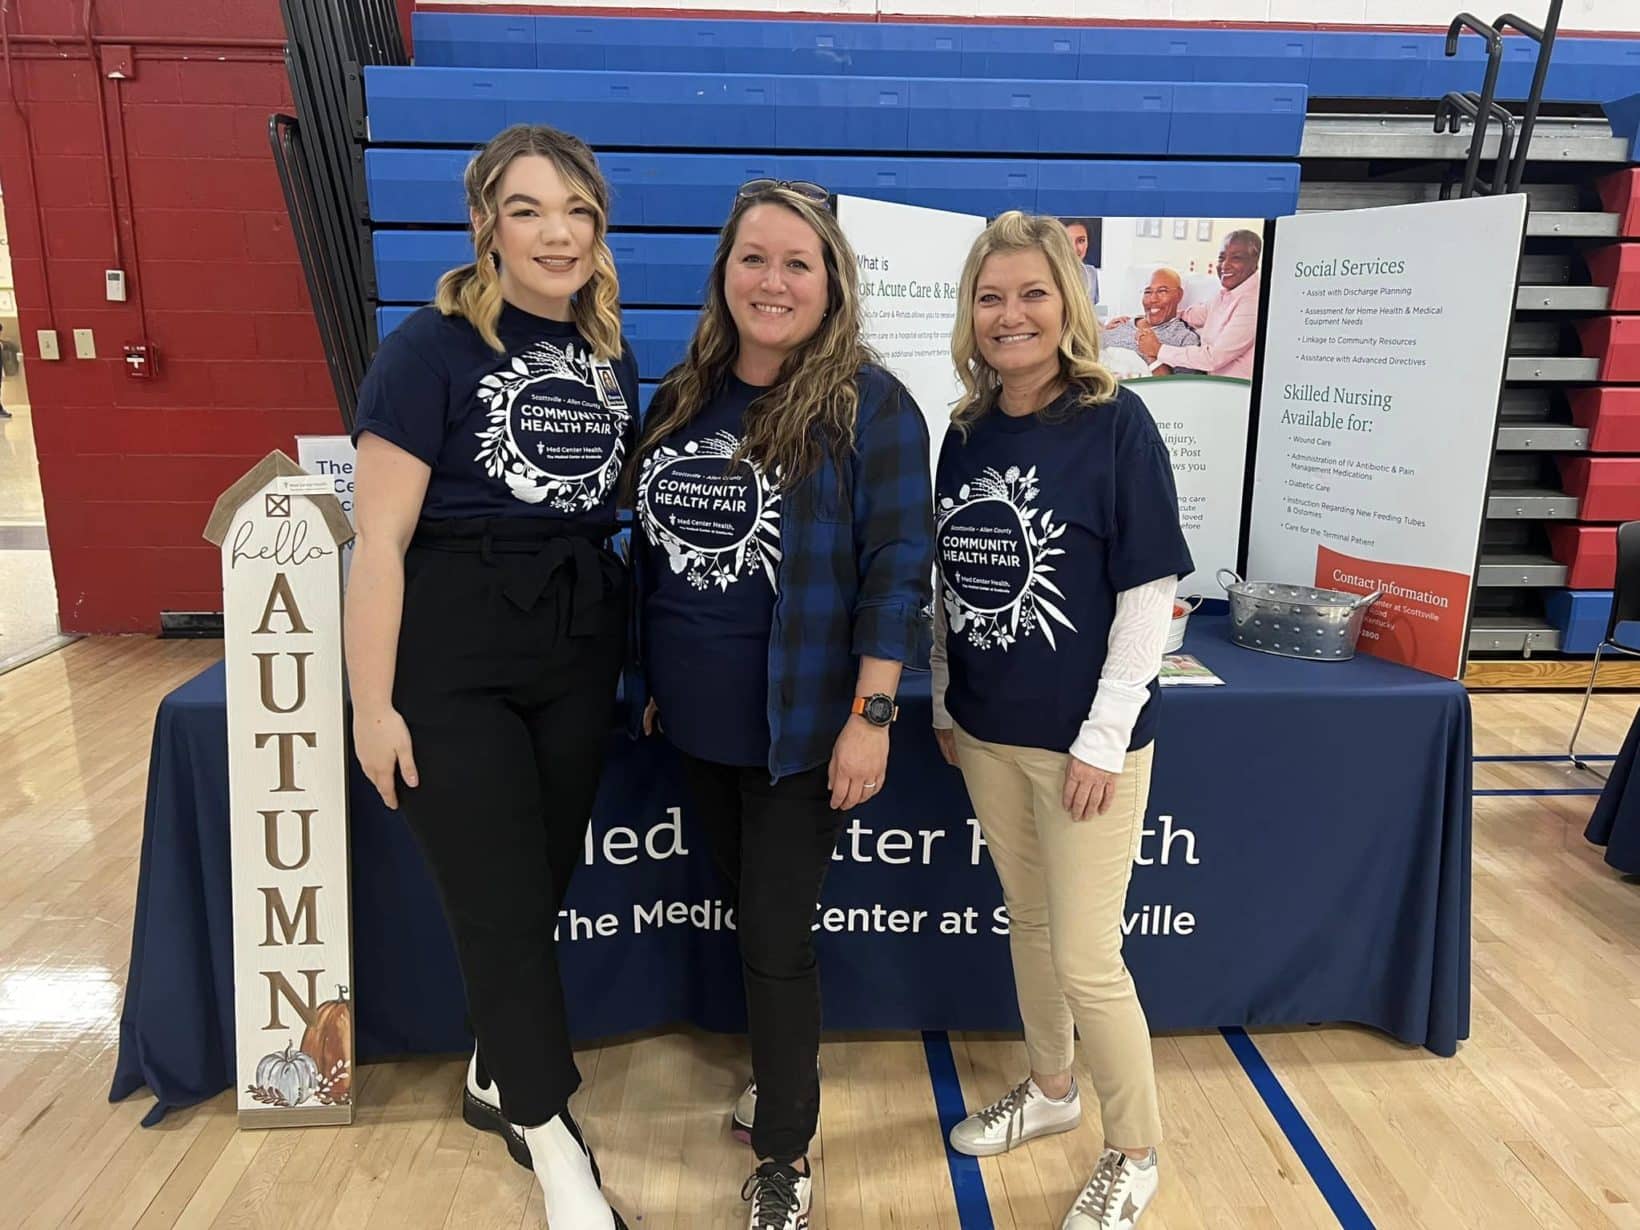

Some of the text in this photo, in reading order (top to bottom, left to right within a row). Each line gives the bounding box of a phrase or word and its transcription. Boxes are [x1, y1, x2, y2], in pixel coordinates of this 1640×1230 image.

[882, 257, 889, 271] is
[1295, 257, 1405, 278] Social Services
[859, 281, 875, 296] ost
[877, 280, 907, 297] Acute
[910, 281, 932, 298] Care
[934, 282, 941, 298] &
[1344, 288, 1378, 296] Discharge
[1380, 287, 1412, 296] Planning
[1412, 306, 1443, 314] Medical
[1304, 318, 1363, 326] Equipment Needs
[1301, 336, 1327, 345] Linkage
[1338, 337, 1377, 347] Community
[1379, 337, 1417, 346] Resources
[1300, 354, 1335, 362] Assistance
[1352, 356, 1387, 365] Advanced
[1389, 357, 1426, 366] Directives
[1283, 384, 1392, 412] Skilled Nursing
[520, 418, 611, 435] HEALTH FAIR
[1280, 409, 1373, 433] Available for:
[1165, 434, 1197, 445] injury,
[1293, 436, 1332, 446] Wound Care
[1180, 448, 1201, 457] Post
[316, 460, 353, 475] The
[1188, 463, 1206, 472] you
[1290, 463, 1373, 480] Management Medications
[1291, 453, 1337, 465] Administration
[1355, 461, 1391, 473] Antibiotic
[1391, 465, 1397, 473] &
[1398, 466, 1415, 476] Pain
[658, 479, 748, 497] COMMUNITY
[1288, 480, 1331, 493] Diabetic Care
[655, 492, 746, 513] HEALTH FAIR
[1321, 502, 1355, 516] Regarding
[1356, 508, 1372, 518] New
[1373, 512, 1402, 524] Feeding
[1404, 516, 1426, 527] Tubes
[1181, 522, 1201, 530] efore
[1284, 522, 1299, 532] Care
[1300, 525, 1309, 534] for
[1323, 530, 1349, 542] Terminal
[1351, 535, 1375, 547] Patient
[232, 519, 333, 569] hello
[942, 536, 1018, 552] COMMUNITY
[943, 550, 1021, 567] HEALTH FAIR
[1333, 569, 1449, 608] Contact Information
[831, 819, 945, 865] ter
[633, 900, 737, 934] Medic
[939, 907, 979, 935] at
